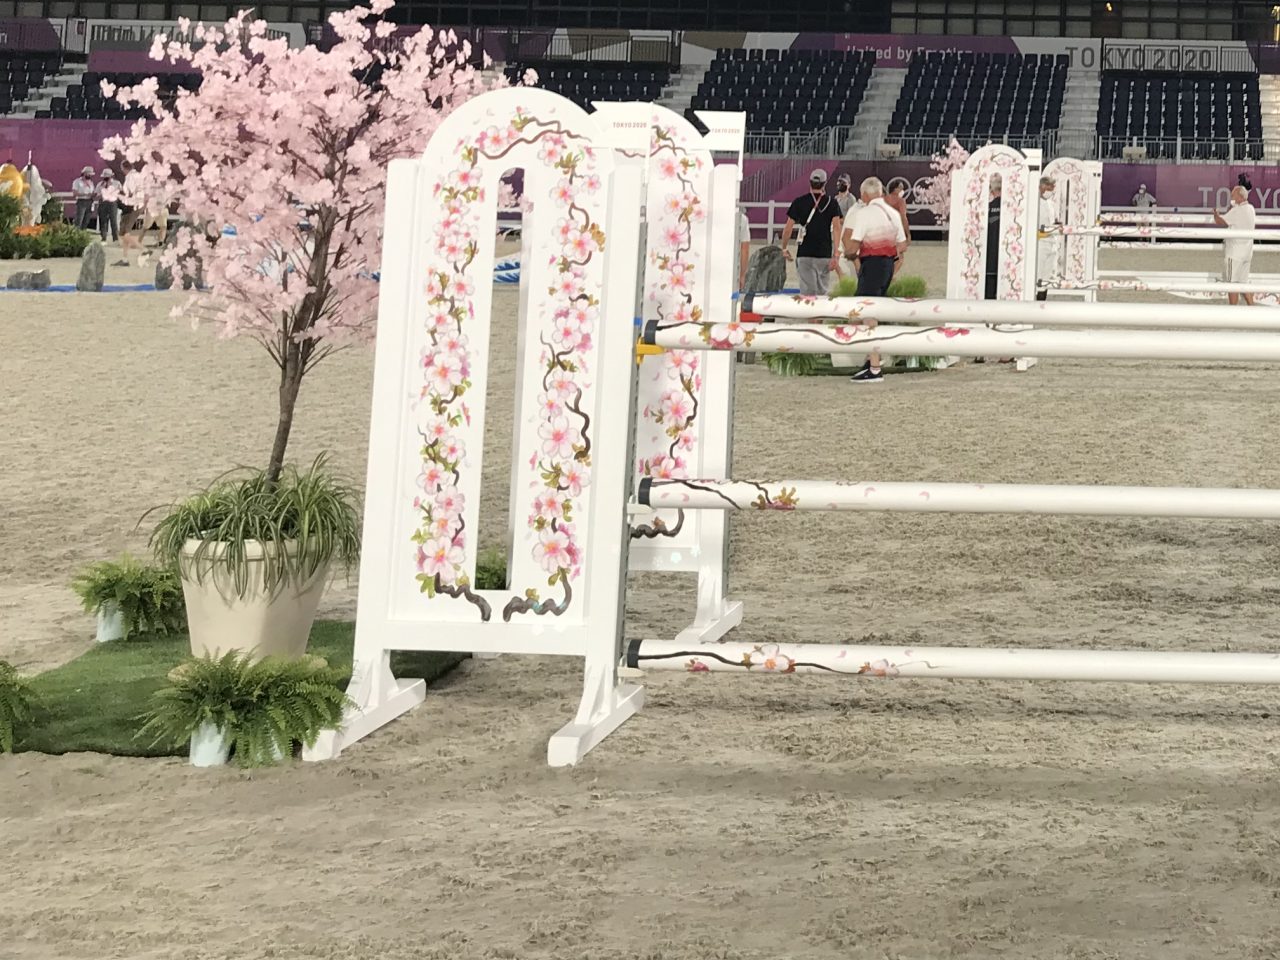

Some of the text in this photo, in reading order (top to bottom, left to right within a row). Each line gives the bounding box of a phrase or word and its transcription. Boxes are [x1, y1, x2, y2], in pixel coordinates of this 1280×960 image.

[897, 47, 912, 63] by
[1065, 46, 1212, 71] TOKYO 2020
